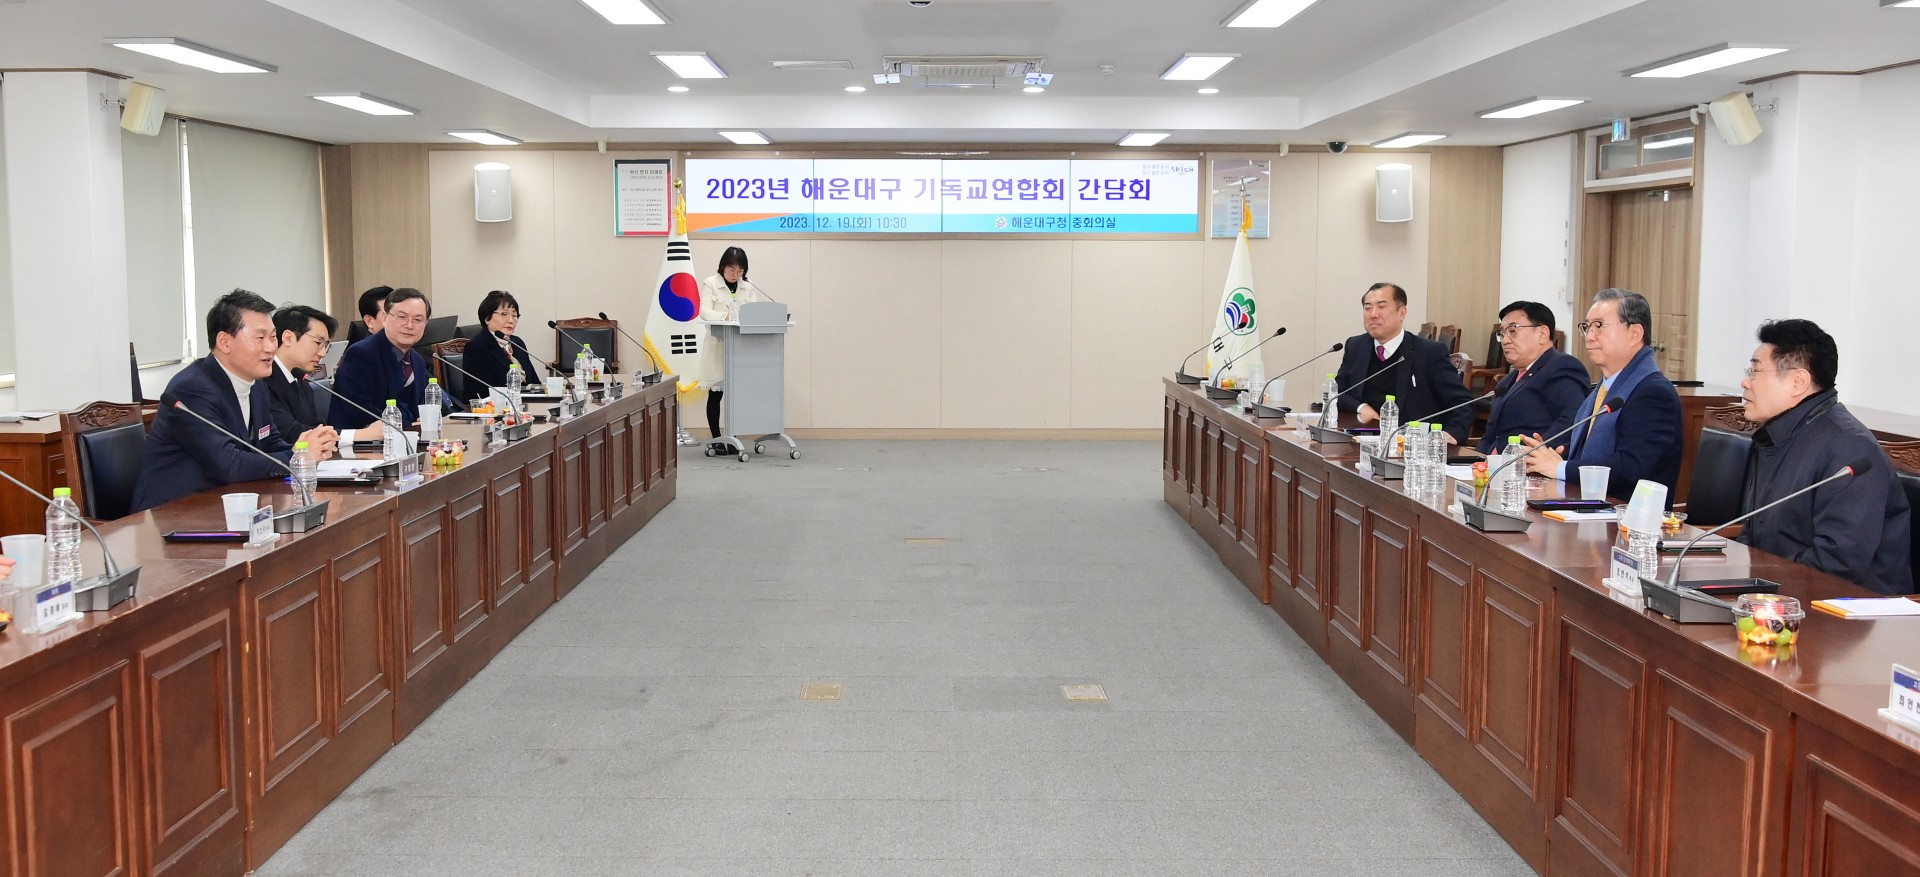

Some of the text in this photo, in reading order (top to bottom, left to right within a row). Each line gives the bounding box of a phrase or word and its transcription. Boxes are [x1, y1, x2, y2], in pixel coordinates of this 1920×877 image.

[706, 178, 1151, 201] 2023년 해운대구 기독교연합회 간담회
[779, 216, 811, 229] 2023.
[816, 216, 832, 229] 12.
[876, 216, 908, 229] 10:30
[1010, 216, 1116, 229] 해운대구청 중회의실
